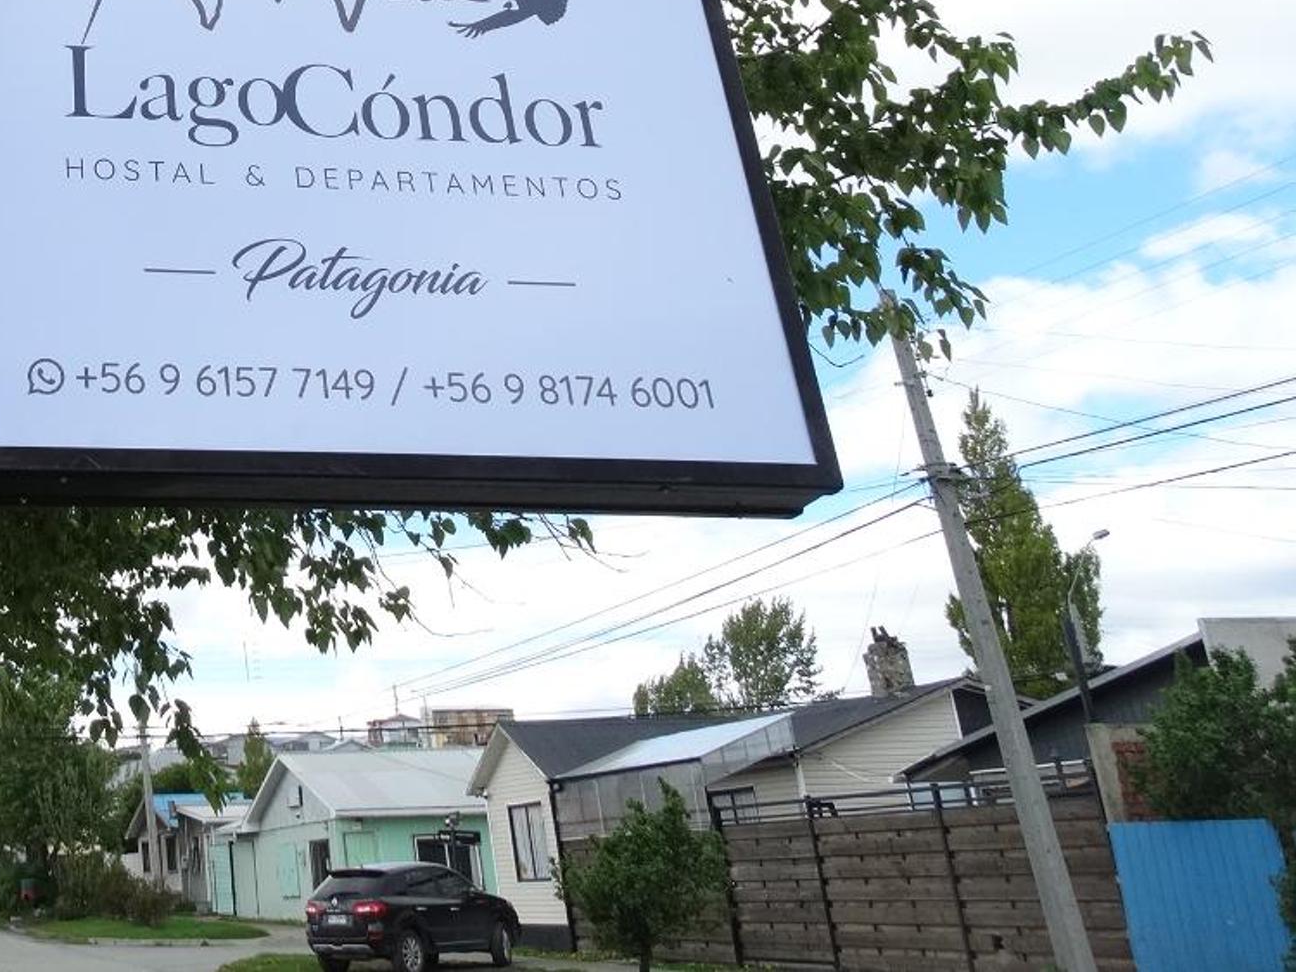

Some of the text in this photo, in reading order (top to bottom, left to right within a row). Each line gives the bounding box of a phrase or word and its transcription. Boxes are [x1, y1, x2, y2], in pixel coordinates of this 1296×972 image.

[65, 44, 604, 149] LagoCóndor
[65, 158, 622, 201] HOSTAL & DEPARTAMENTOS
[232, 238, 488, 320] Patagonia
[75, 362, 715, 409] +56 9 6157 7149 / +56 9 8174 6001
